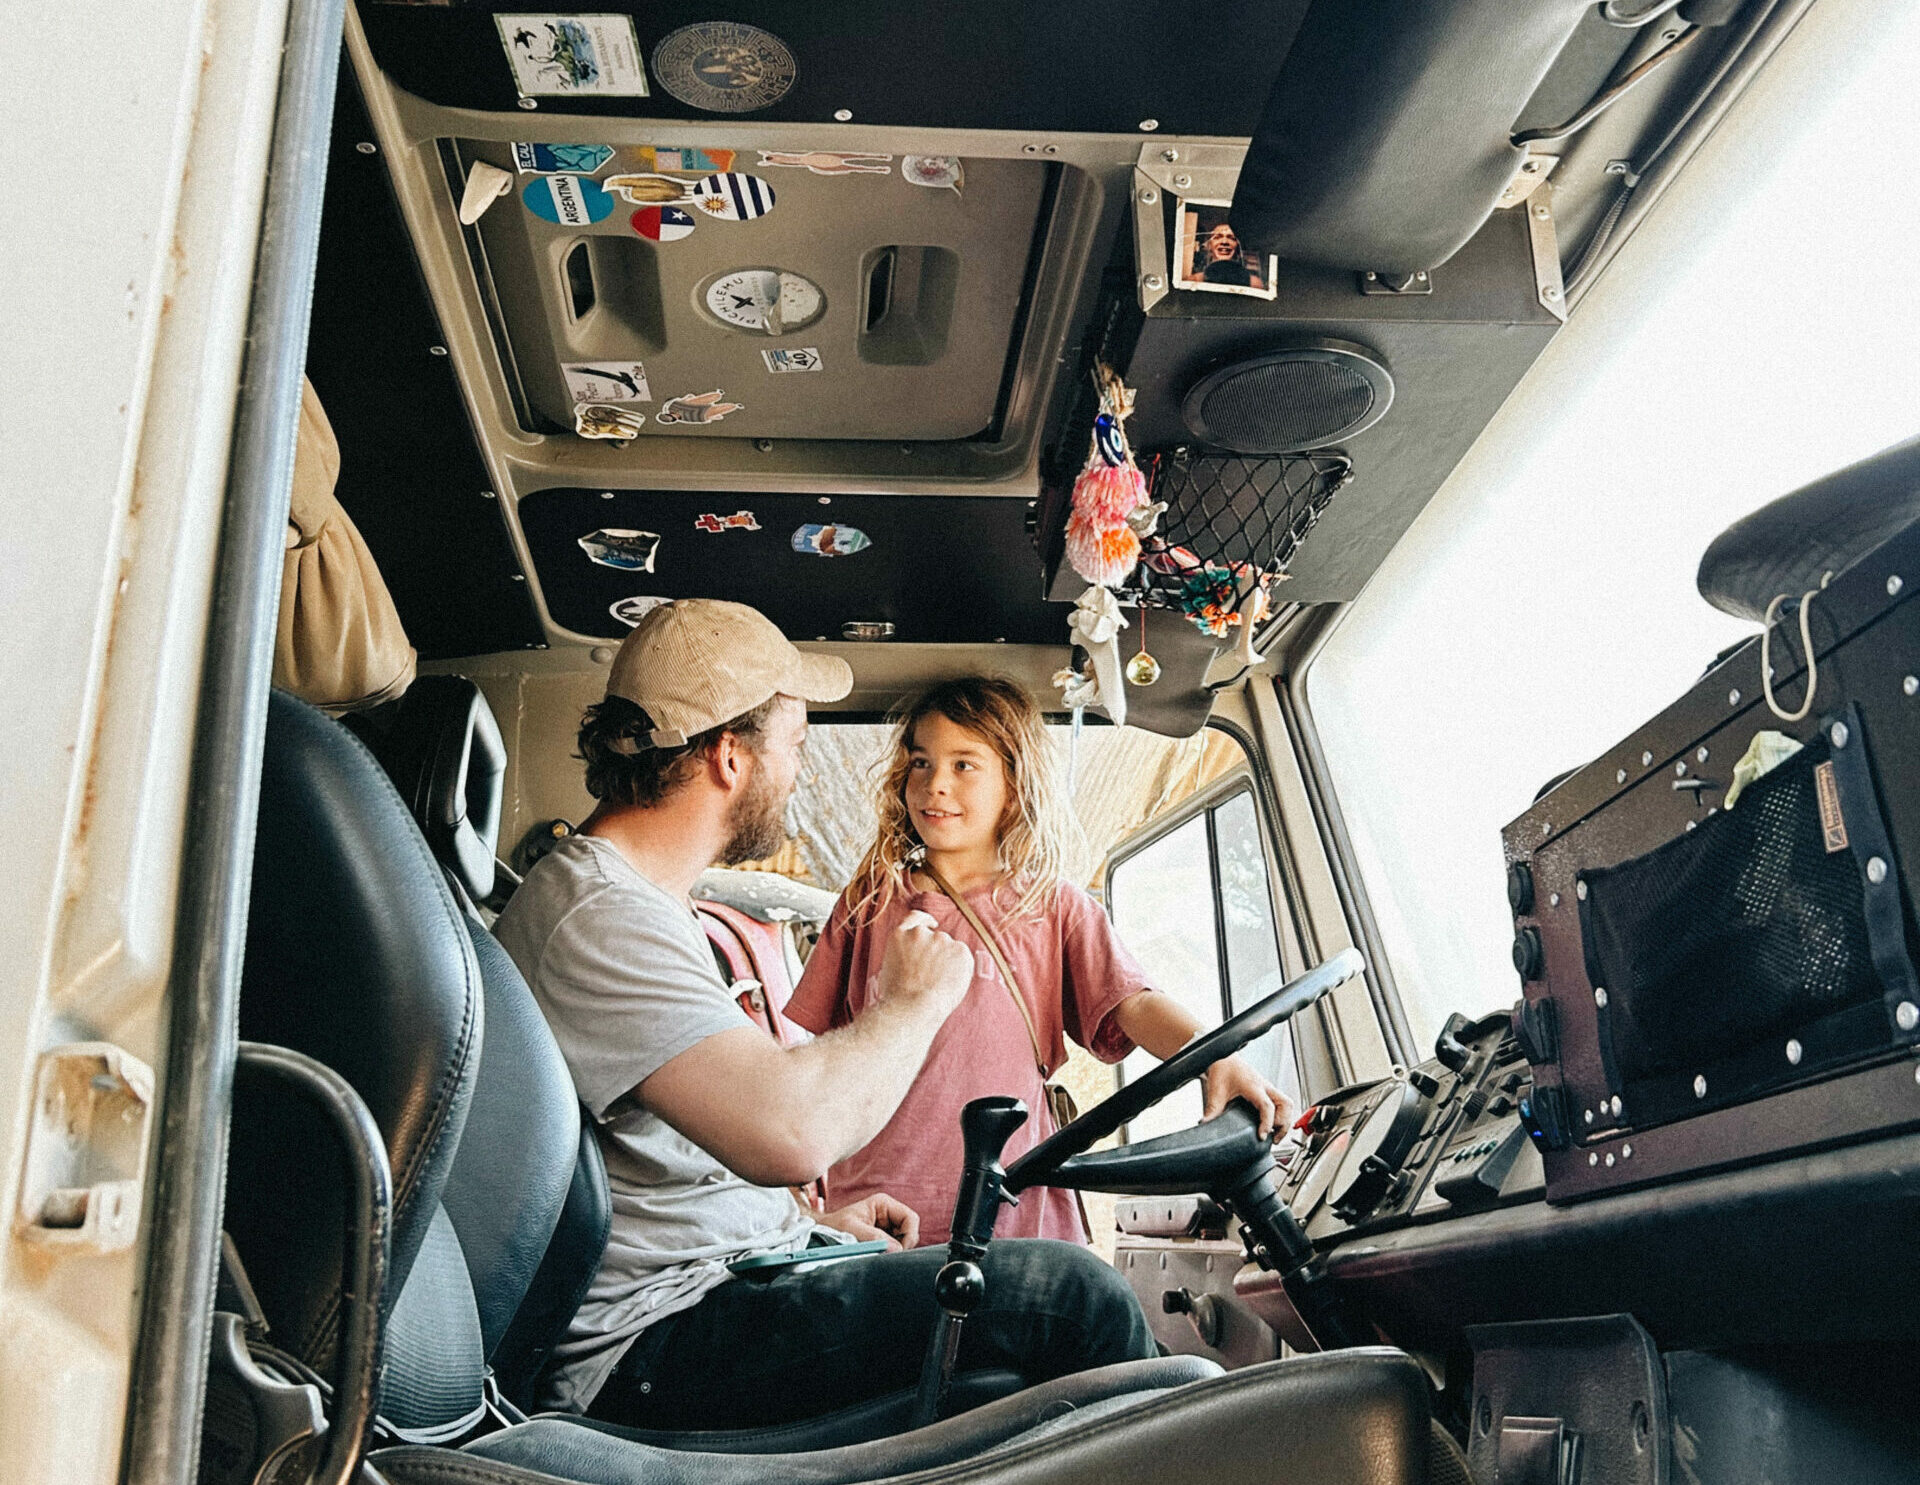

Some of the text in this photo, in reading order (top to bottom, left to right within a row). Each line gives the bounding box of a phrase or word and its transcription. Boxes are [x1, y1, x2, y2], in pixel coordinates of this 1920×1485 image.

[521, 159, 532, 168] EL
[555, 177, 580, 224] ARGENTINA
[715, 276, 756, 325] PICHILEMU
[792, 352, 808, 368] 40
